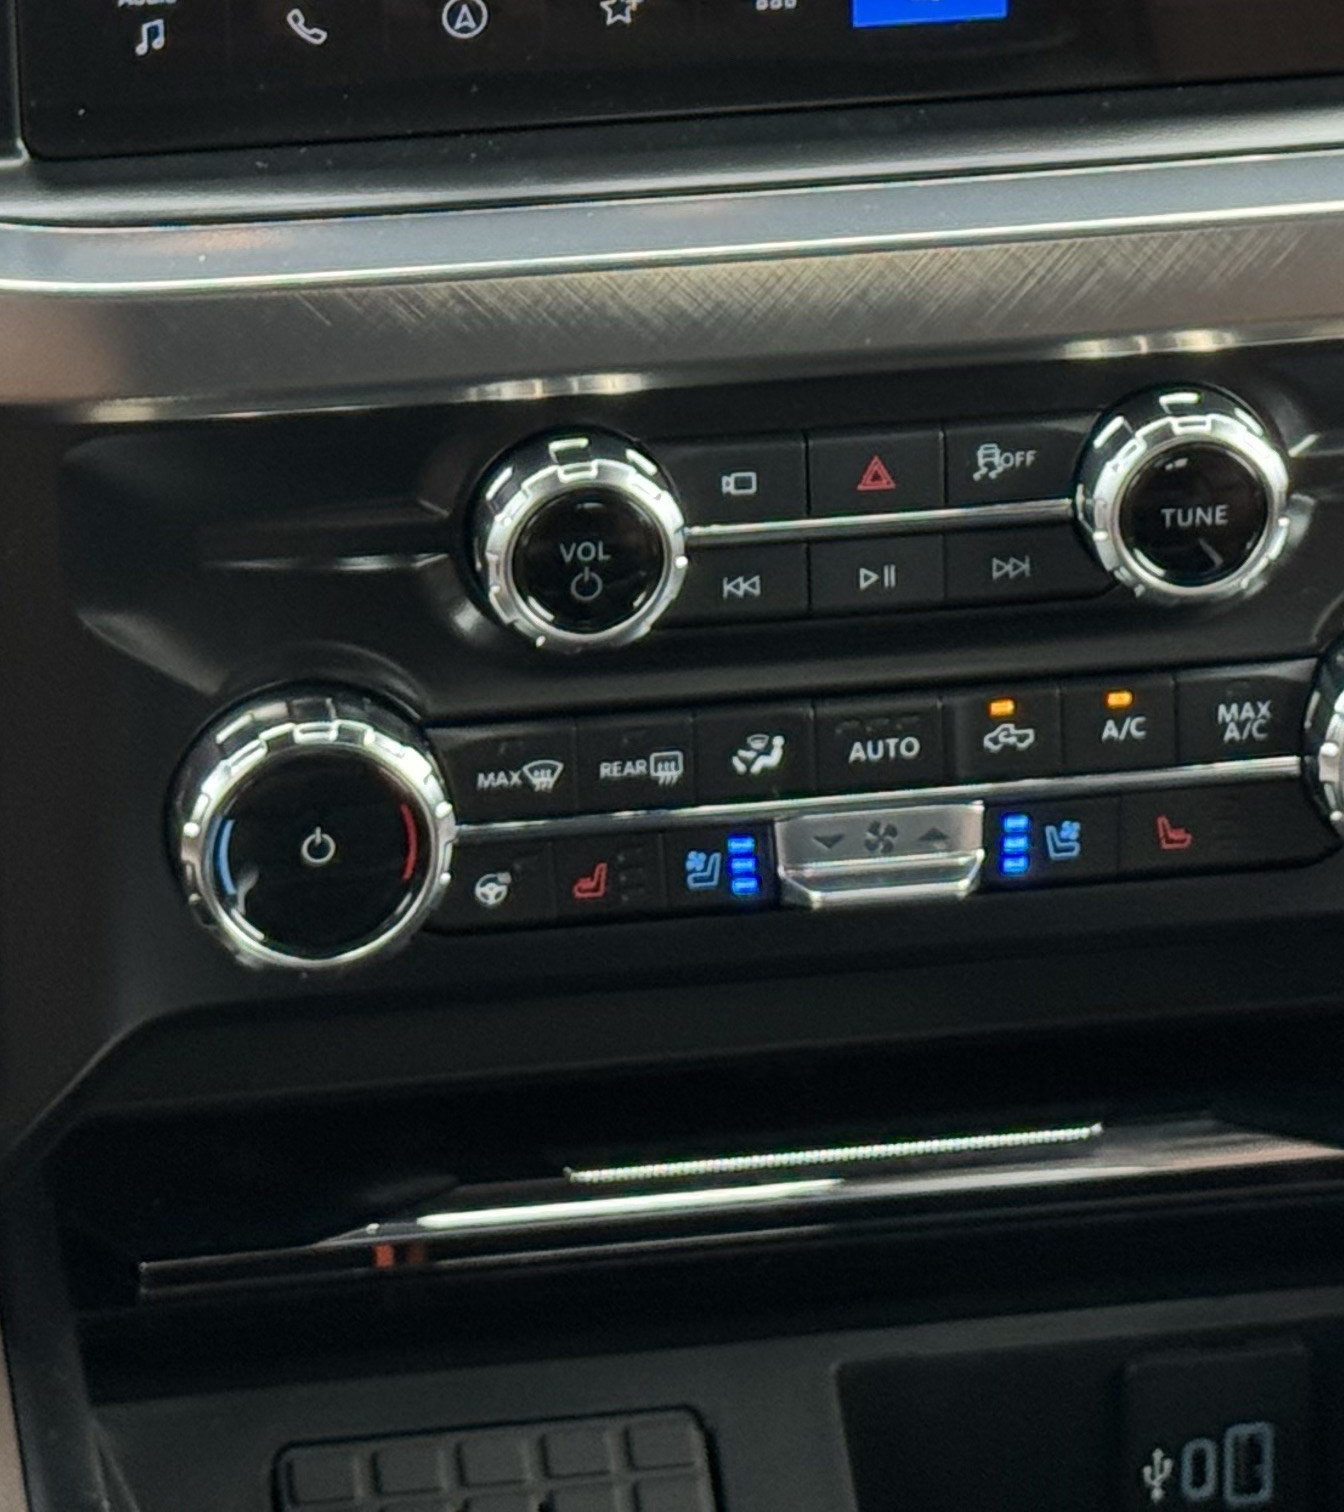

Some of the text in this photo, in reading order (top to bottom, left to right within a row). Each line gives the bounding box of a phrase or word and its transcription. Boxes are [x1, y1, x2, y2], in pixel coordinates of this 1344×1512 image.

[1000, 449, 1037, 471] OFF
[1161, 506, 1229, 530] TUNE
[559, 540, 612, 563] VOL
[1218, 700, 1272, 724] MAX
[1101, 715, 1147, 743] A/C
[1223, 720, 1269, 744] A/C
[848, 737, 921, 764] AUTO
[477, 771, 521, 790] MAX
[599, 759, 647, 782] REAR
